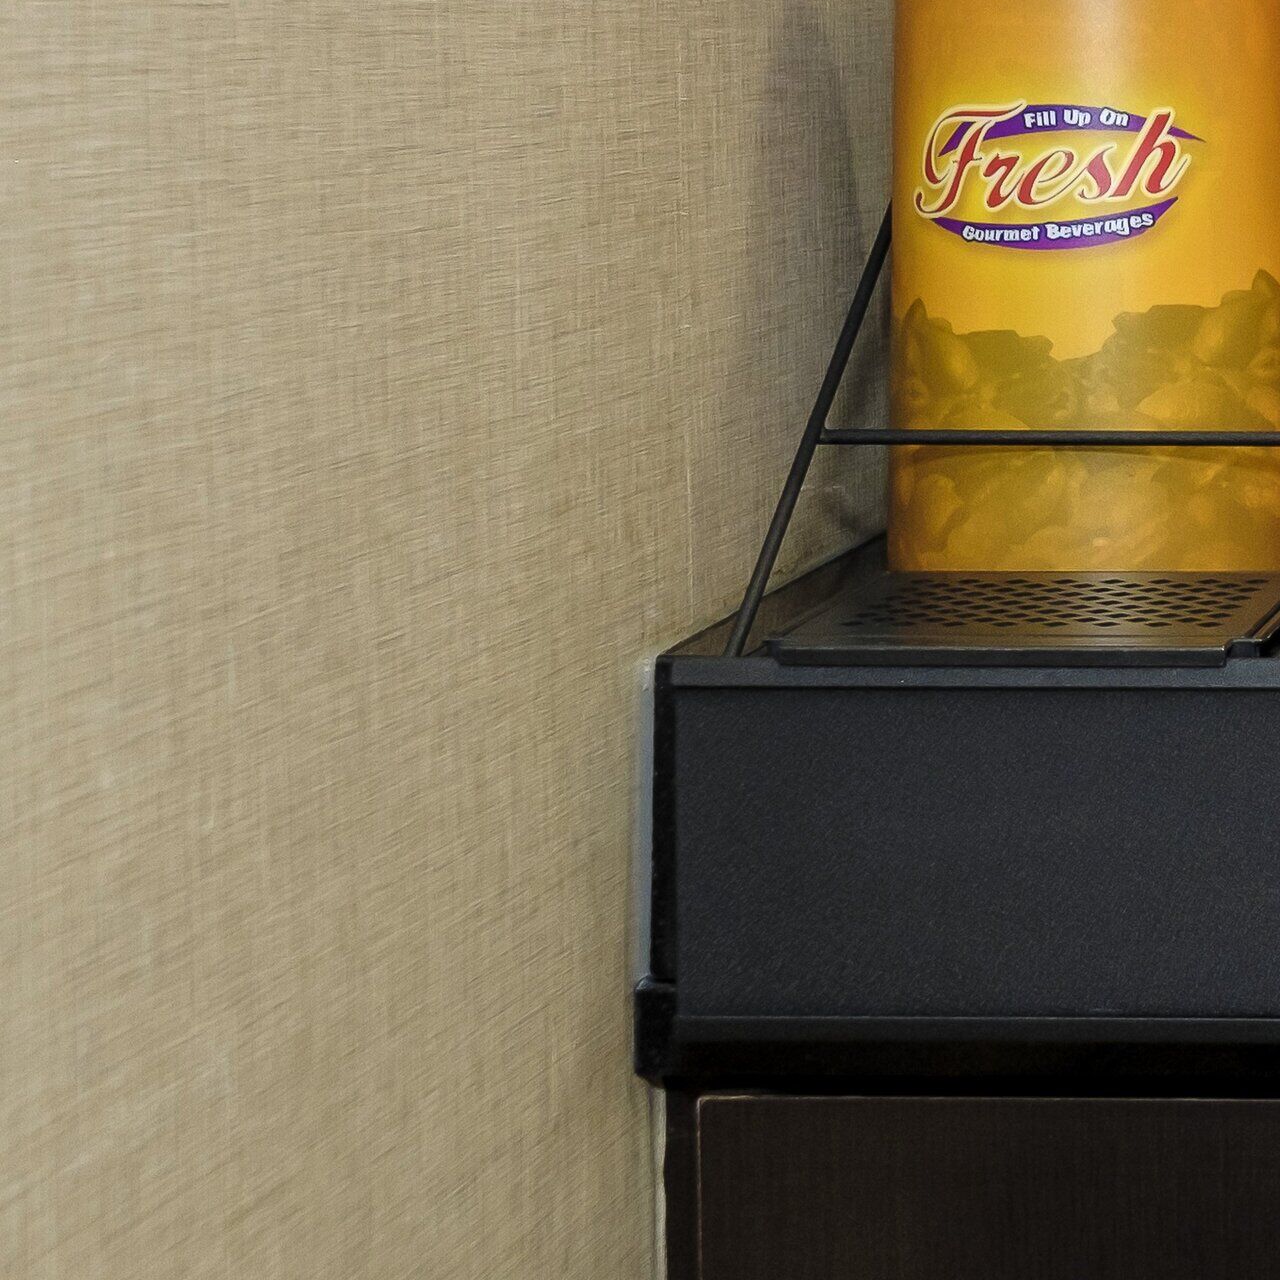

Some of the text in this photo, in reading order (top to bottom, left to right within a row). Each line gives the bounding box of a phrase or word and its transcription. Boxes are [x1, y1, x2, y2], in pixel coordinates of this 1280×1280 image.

[1023, 107, 1129, 128] Fill Up On
[915, 100, 1190, 217] Fresh
[961, 211, 1154, 243] Gourmet Beverages
